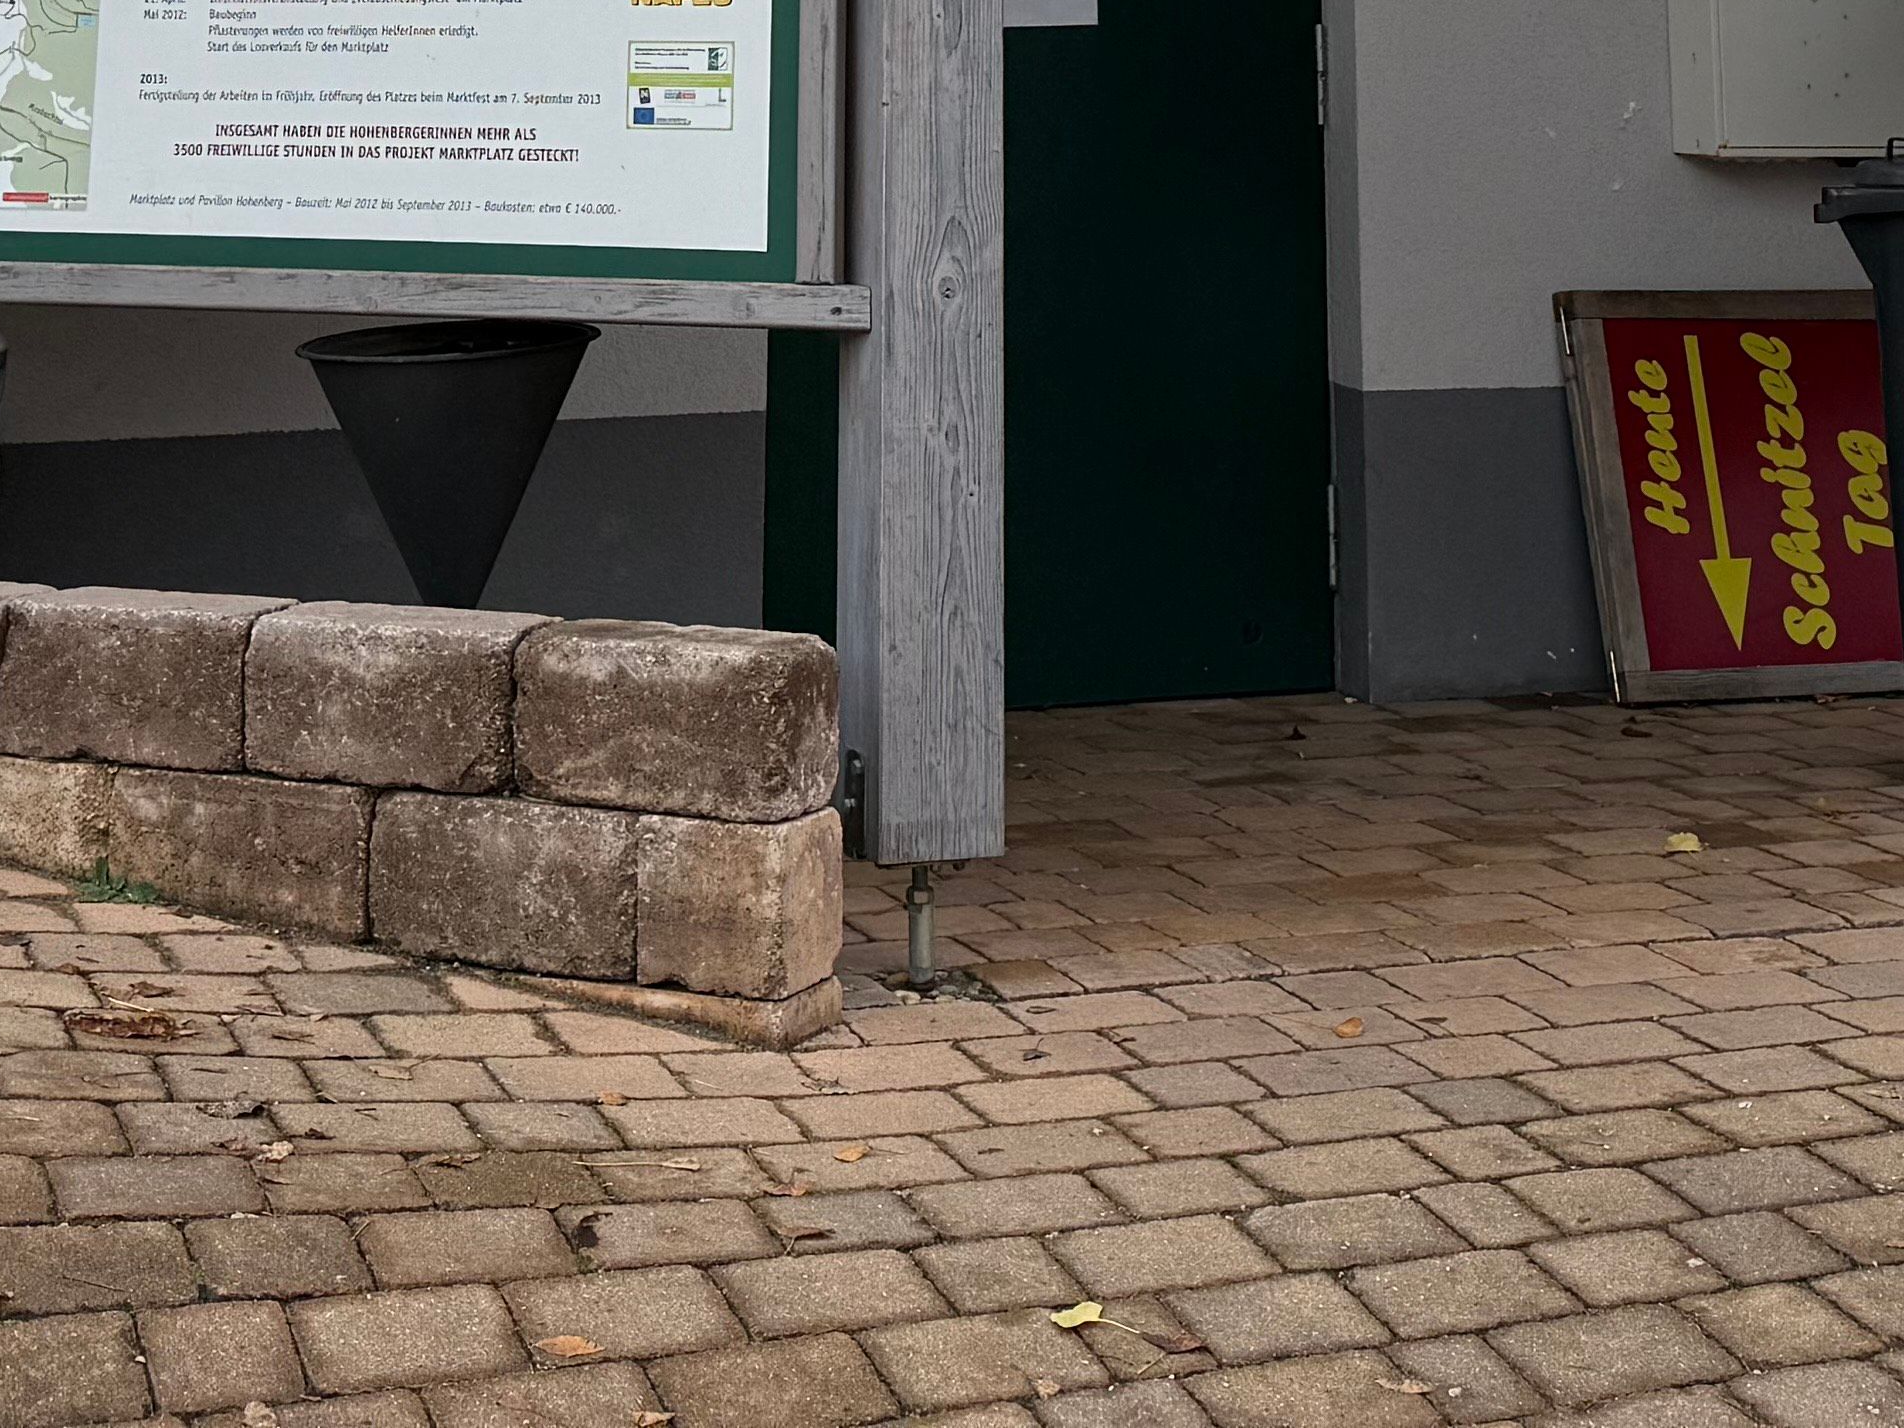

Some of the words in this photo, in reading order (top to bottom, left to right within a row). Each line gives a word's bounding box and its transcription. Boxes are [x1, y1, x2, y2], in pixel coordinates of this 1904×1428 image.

[139, 73, 168, 84] 2013:
[577, 93, 601, 105] 2013
[215, 124, 279, 137] INSGESAMT
[282, 124, 322, 138] HABEN
[326, 125, 346, 138] DIE
[349, 125, 472, 139] HOHENBERGERINNEN
[476, 127, 510, 140] MEHR
[514, 127, 536, 141] ALS
[173, 143, 203, 156] 3500
[206, 143, 280, 157] FREIWILLIGE
[283, 144, 336, 157] STUNDEN
[340, 145, 354, 158] IN
[358, 145, 381, 158] DAS
[384, 146, 435, 159] PROJEKT
[438, 147, 514, 160] MARKTPLATZ
[518, 148, 579, 162] GESTECKT!
[128, 193, 176, 206] Marktplatz
[178, 195, 196, 205] und
[198, 194, 233, 206] Pavillon
[235, 195, 284, 209] Hohenberg
[294, 196, 332, 208] Bauzeit:
[334, 197, 352, 208] Mai
[353, 198, 378, 209] 2012
[380, 198, 394, 210] bis
[396, 198, 446, 212] September
[447, 200, 472, 211] 2013
[483, 200, 536, 213] Baukosten:
[538, 203, 562, 213] etwa
[565, 202, 572, 214] €
[1628, 359, 1690, 535] Heute
[1739, 332, 1837, 650] Schnitzel
[1837, 429, 1895, 555] Tag
